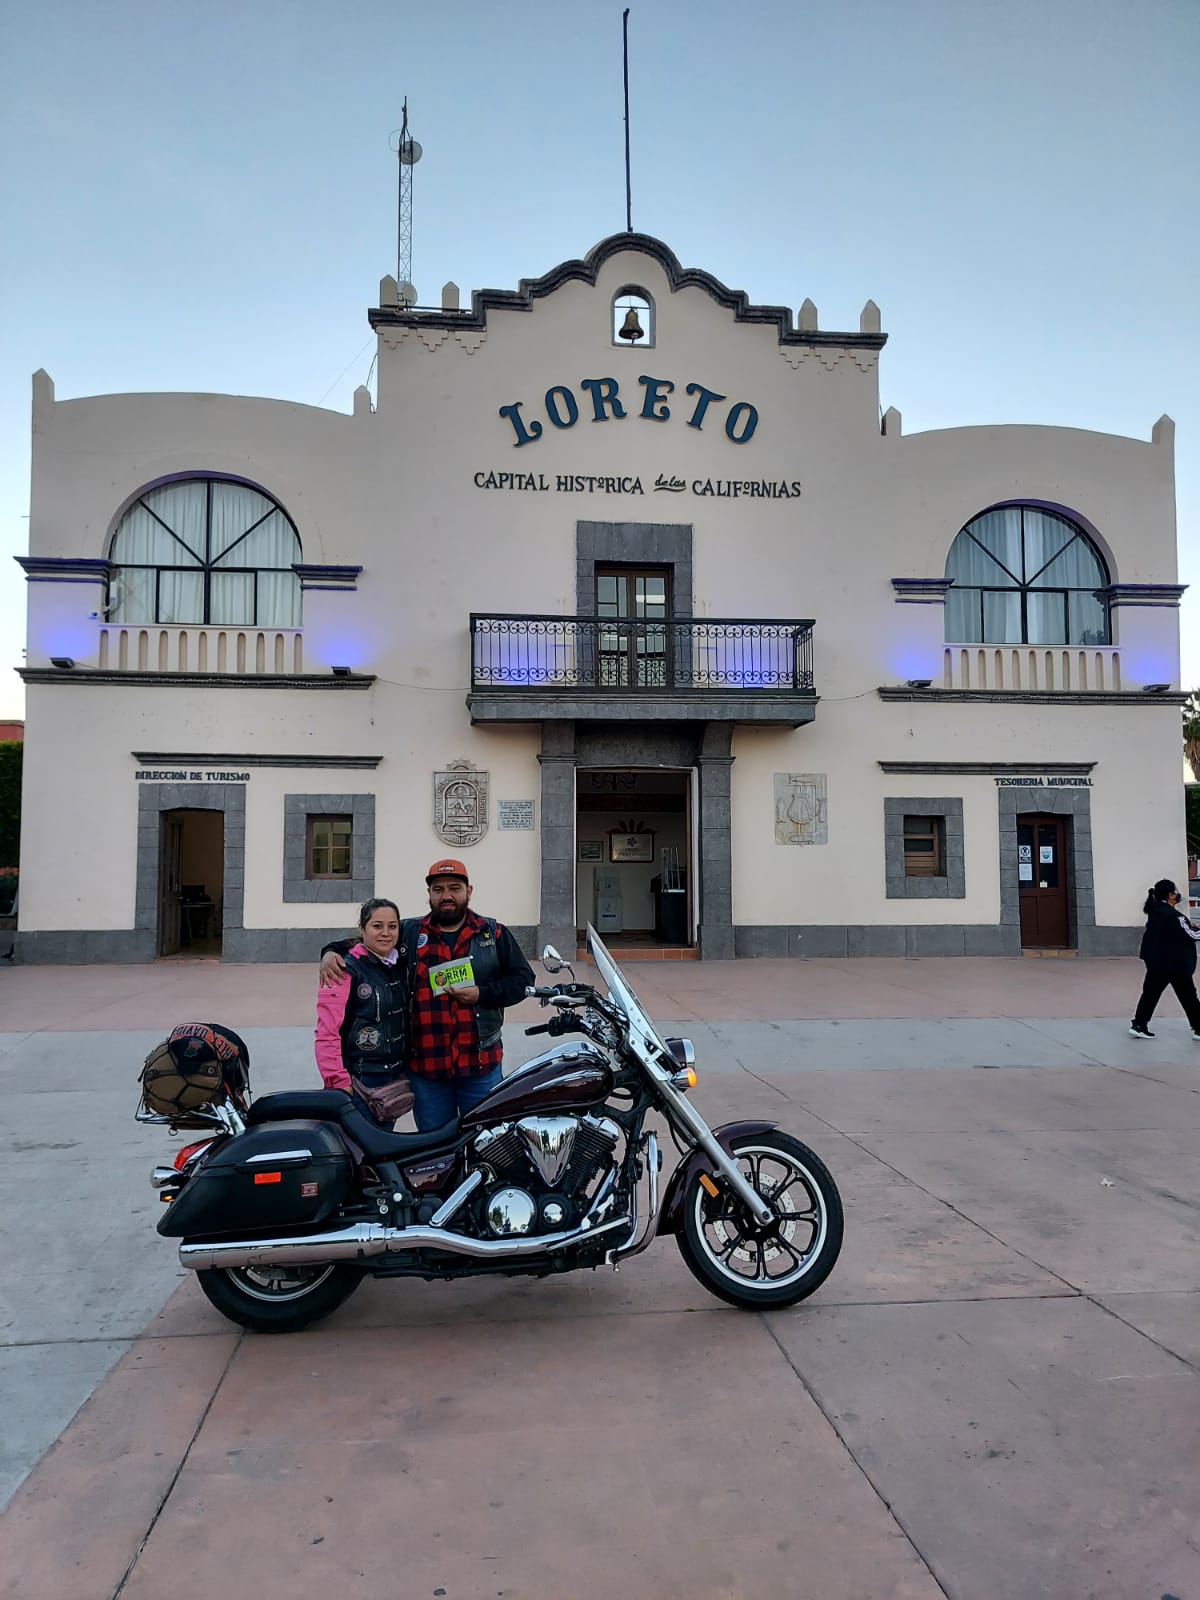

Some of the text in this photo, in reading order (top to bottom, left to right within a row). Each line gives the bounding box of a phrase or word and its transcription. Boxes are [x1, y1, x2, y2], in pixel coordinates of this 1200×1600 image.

[499, 375, 759, 448] LORETO
[474, 470, 549, 491] CAPITAL
[556, 475, 645, 494] HISTORICA
[692, 479, 801, 498] CALIFORNIAS
[135, 771, 250, 781] DIRECCION DE TURISMO
[994, 777, 1094, 787] TESORERIA MUNICIPAL
[446, 968, 467, 981] RRM
